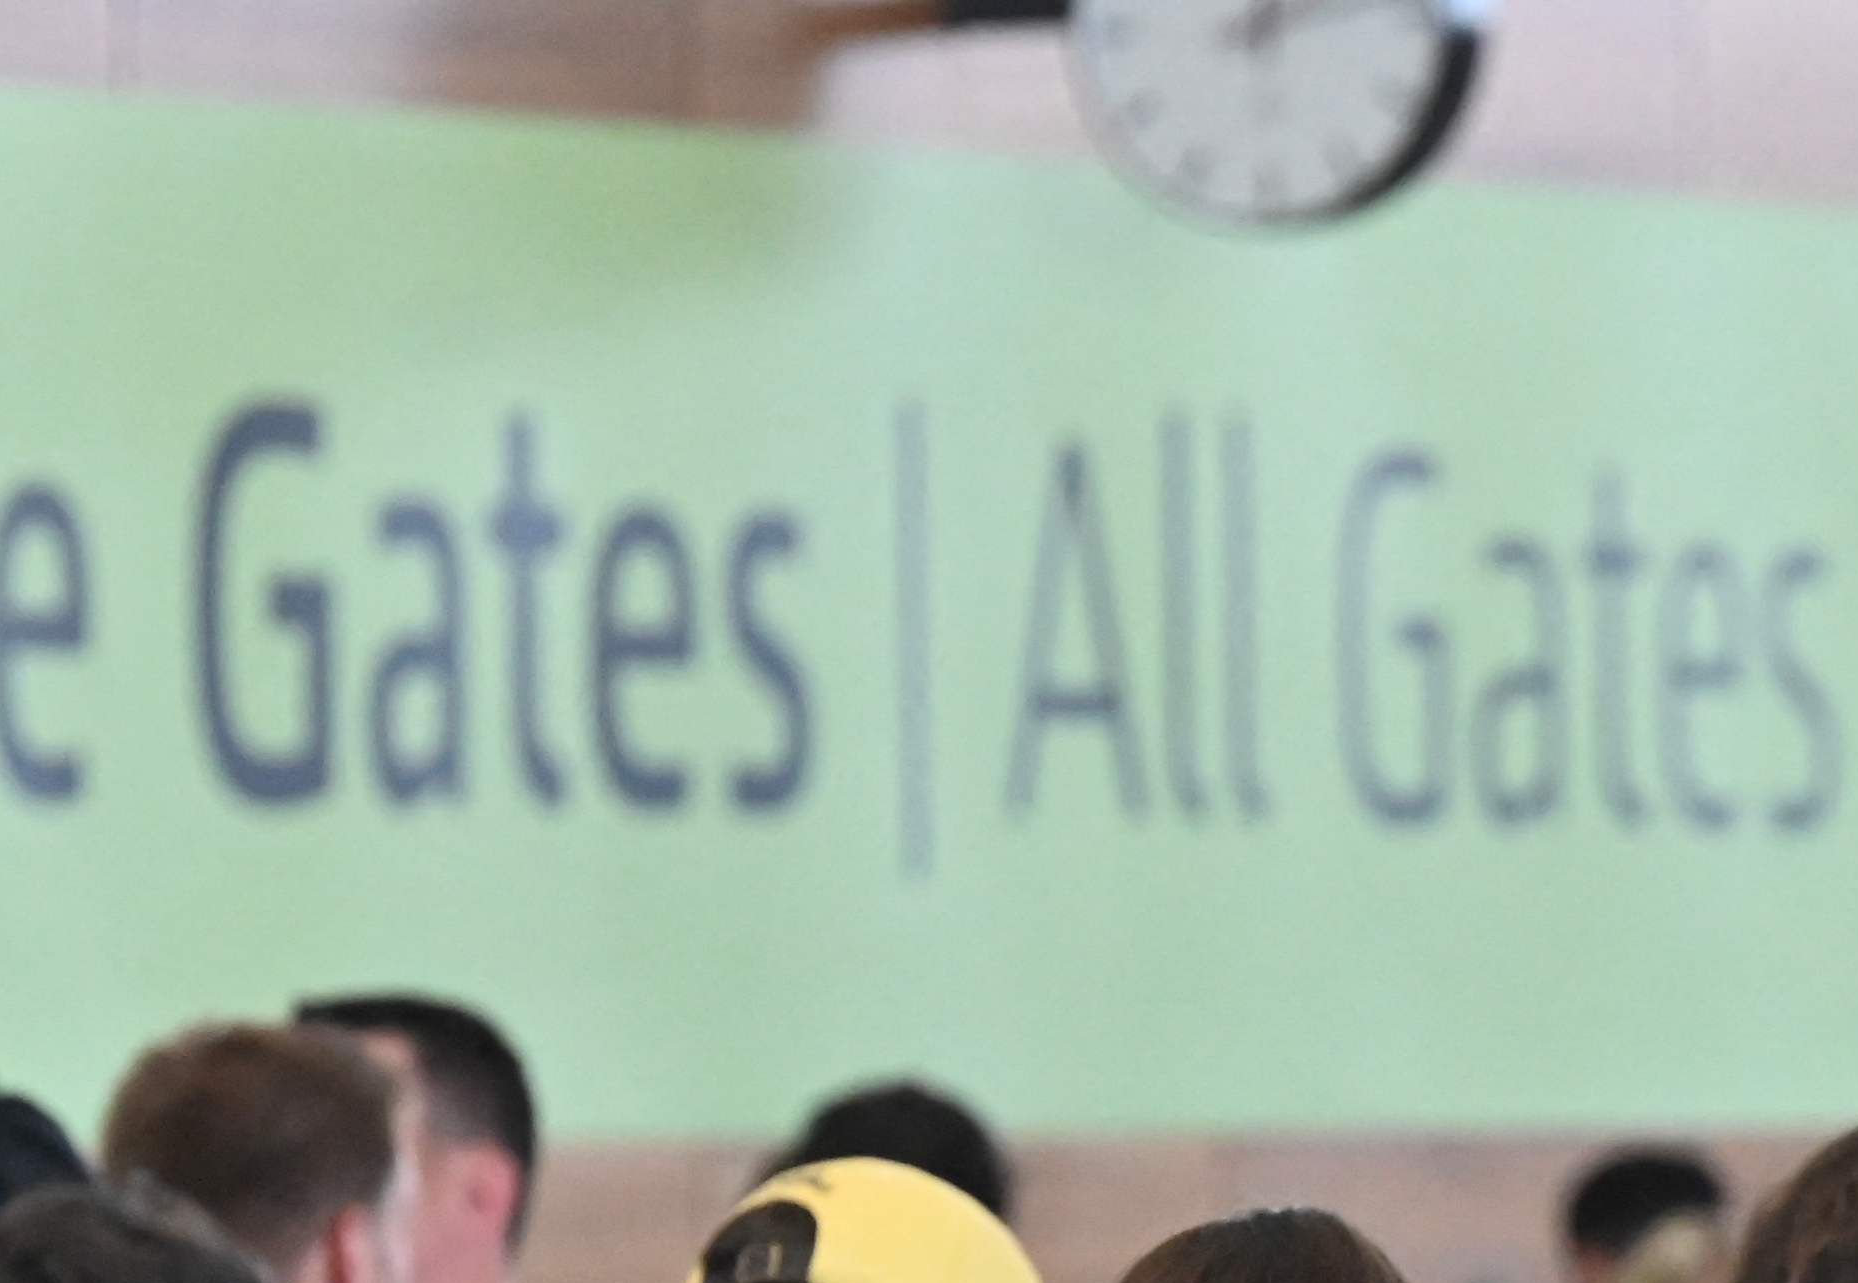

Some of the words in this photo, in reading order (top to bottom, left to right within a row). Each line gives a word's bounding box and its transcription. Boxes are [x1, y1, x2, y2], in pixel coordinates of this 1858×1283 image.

[189, 397, 817, 816] Gates
[1001, 406, 1271, 825] All
[1335, 442, 1845, 836] Gates
